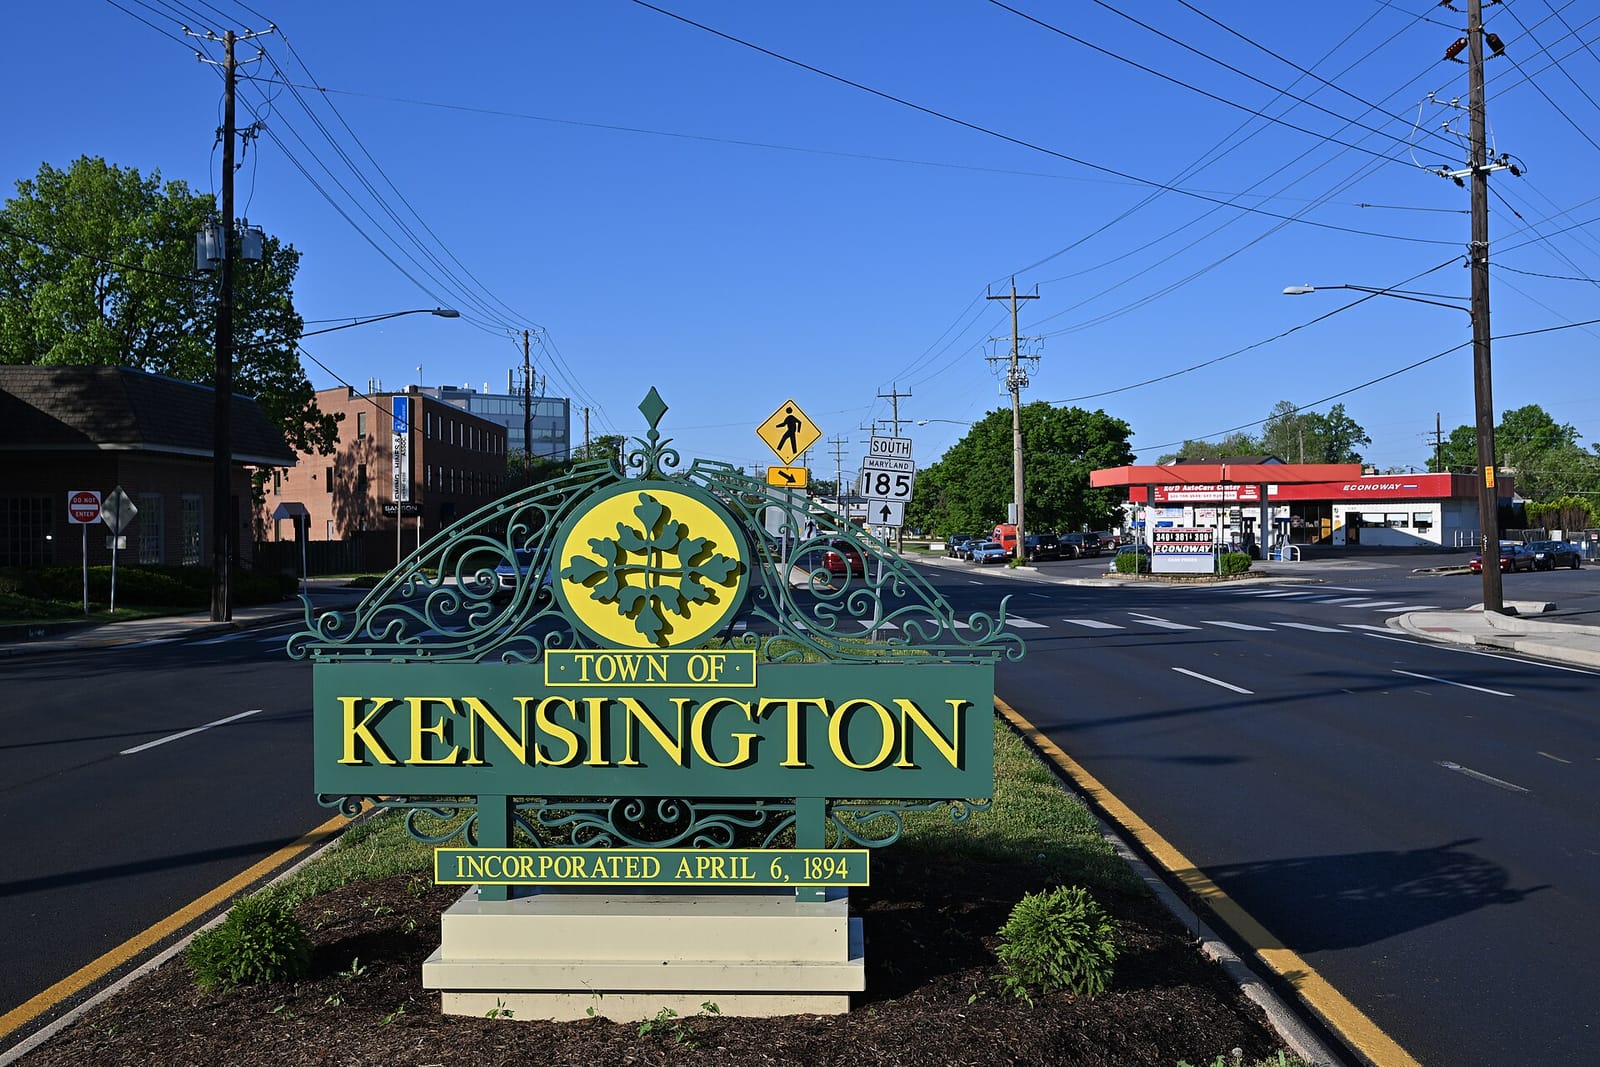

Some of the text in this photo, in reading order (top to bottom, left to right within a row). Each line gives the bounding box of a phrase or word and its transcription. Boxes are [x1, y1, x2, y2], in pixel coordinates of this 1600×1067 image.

[872, 440, 909, 455] SOUTH
[869, 460, 909, 470] MARYLAND
[864, 472, 910, 497] 185
[1343, 483, 1402, 491] ECONOWAY
[1154, 545, 1211, 553] ECONOWAY
[574, 654, 726, 683] TOWN OF
[336, 695, 967, 770] KENSINGTON
[455, 854, 849, 882] INCORPORATED APRIL 6, 1894
